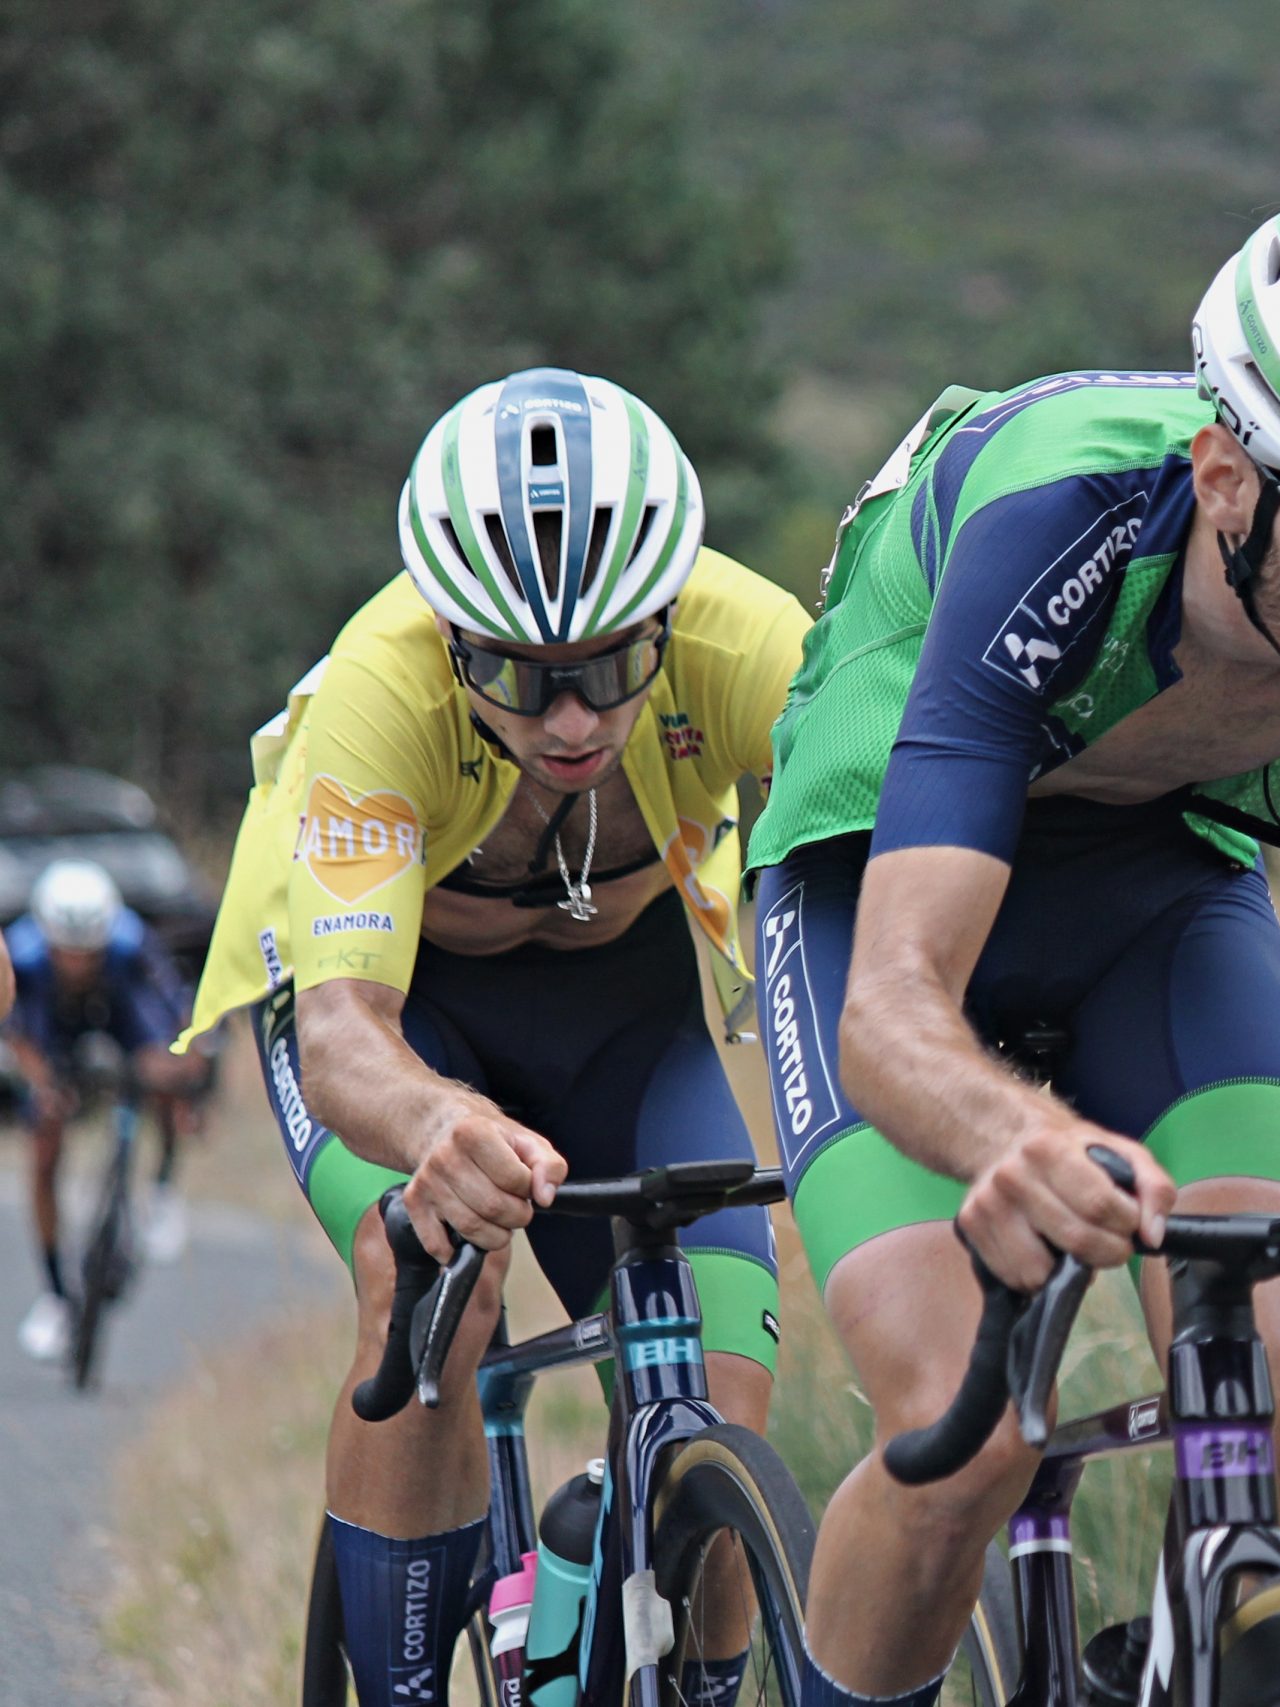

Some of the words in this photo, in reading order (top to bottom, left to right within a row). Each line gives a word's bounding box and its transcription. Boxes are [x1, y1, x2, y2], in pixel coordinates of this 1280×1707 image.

[1247, 314, 1267, 355] CORTIZO
[293, 815, 428, 865] ZAMOR
[313, 913, 393, 936] ENAMORA
[260, 932, 281, 988] ENA
[773, 973, 812, 1135] CORTIZO
[271, 1037, 312, 1152] CORTIZO
[632, 1338, 697, 1366] BH
[1202, 1438, 1269, 1470] BH
[404, 1559, 430, 1660] CORTIZO
